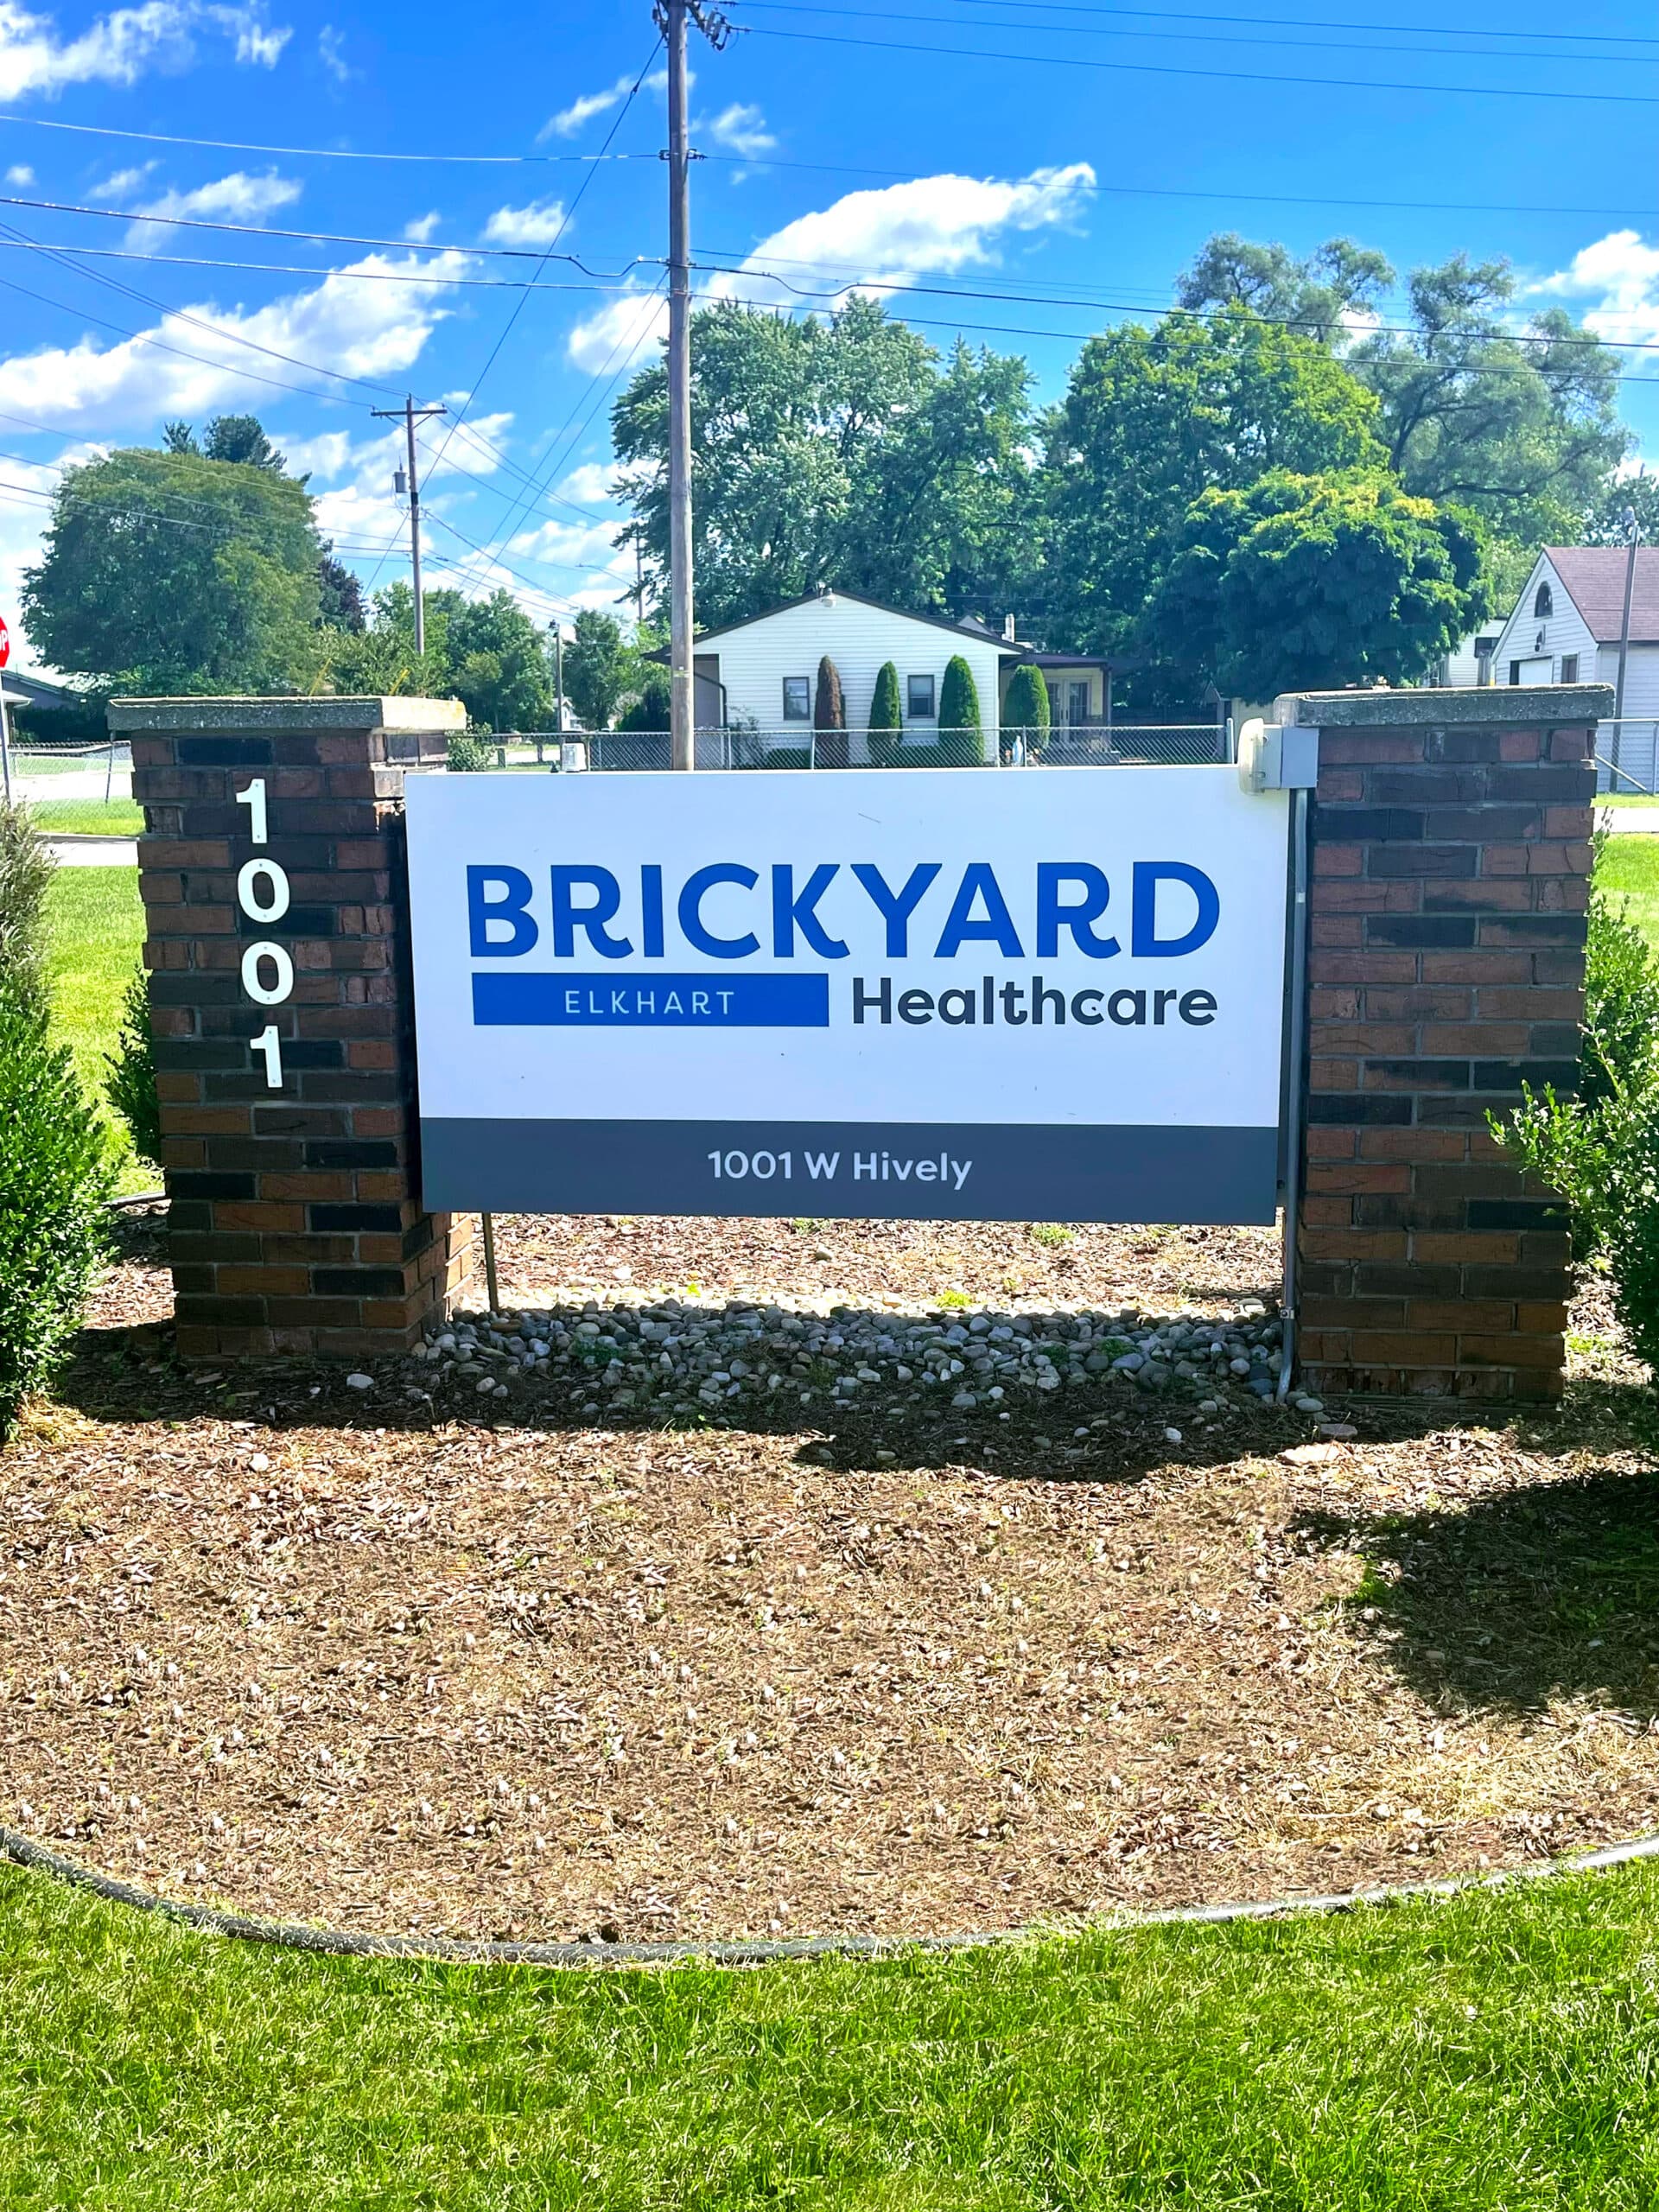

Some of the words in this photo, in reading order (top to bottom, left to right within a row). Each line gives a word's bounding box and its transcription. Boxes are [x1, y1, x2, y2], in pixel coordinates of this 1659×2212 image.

[236, 779, 294, 1089] 1001
[466, 861, 1220, 960] BRICKYARD
[564, 989, 734, 1015] ELKHART
[852, 976, 1218, 1027] Healthcare
[708, 1150, 791, 1179] 1001
[804, 1151, 840, 1179] W
[854, 1151, 973, 1191] Hively
